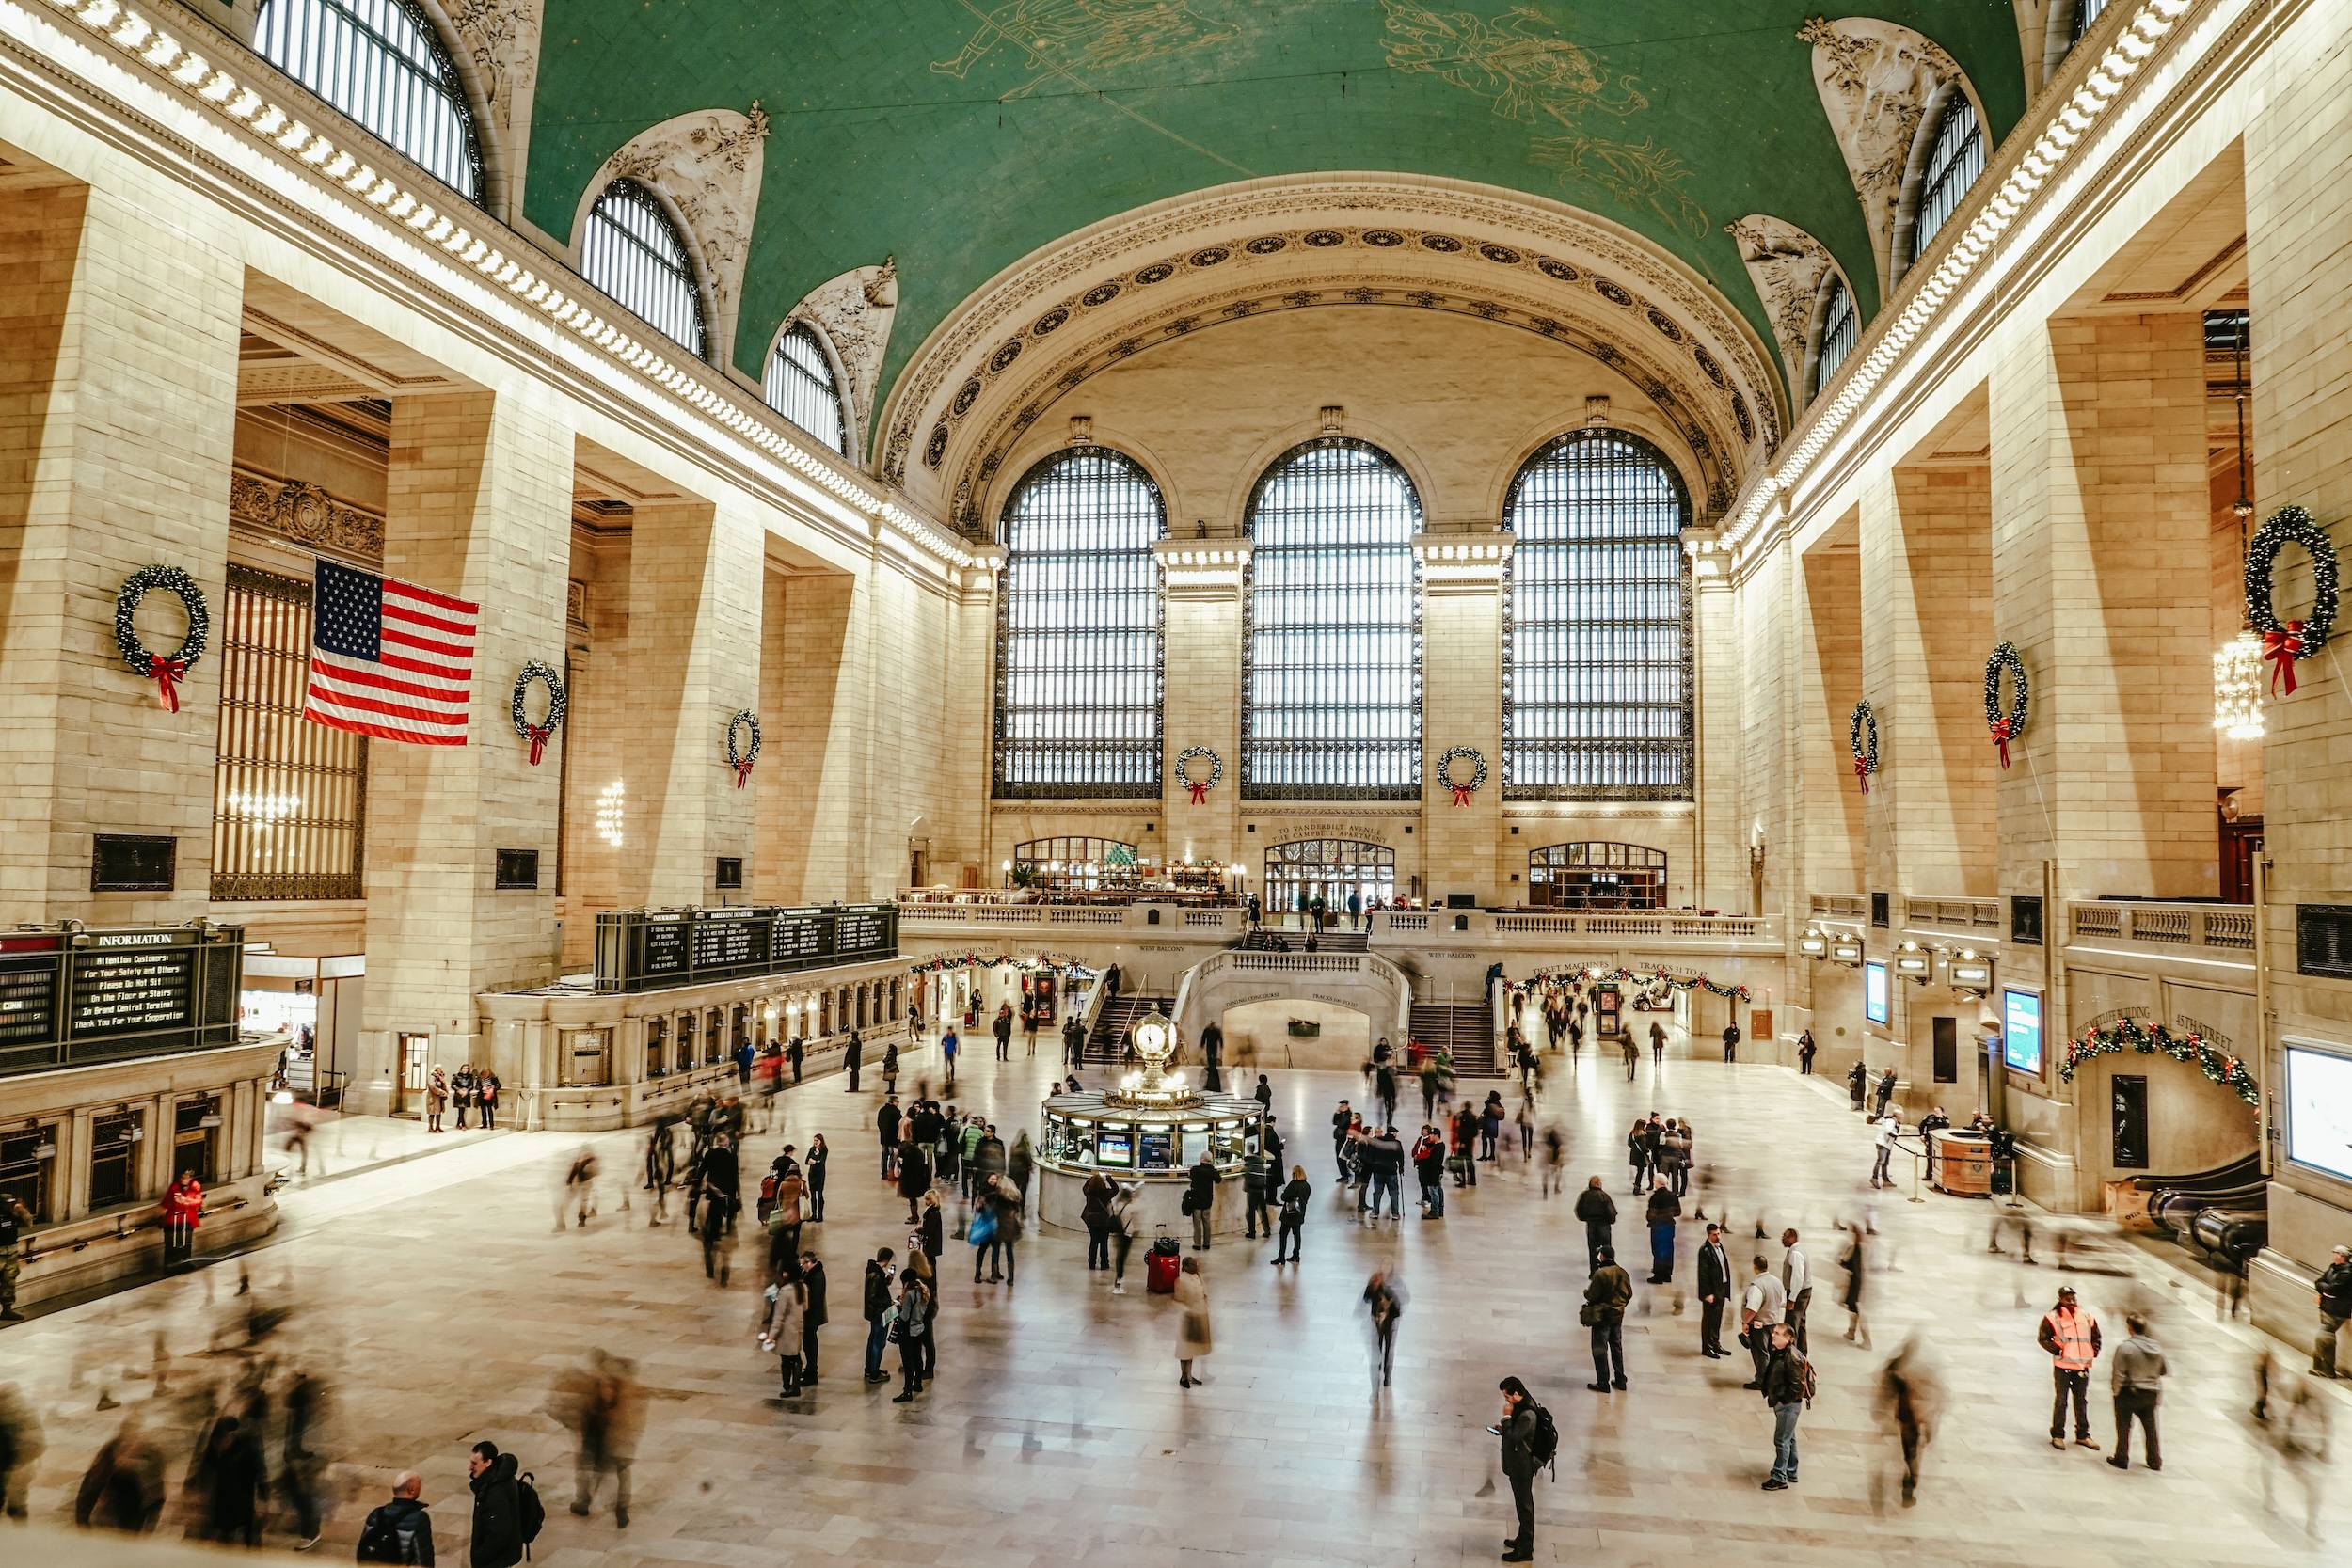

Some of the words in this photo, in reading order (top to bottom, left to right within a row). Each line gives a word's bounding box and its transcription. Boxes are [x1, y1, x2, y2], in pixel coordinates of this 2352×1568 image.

[1349, 825, 1382, 835] AVENUE
[1293, 830, 1334, 839] CAMPBELL
[1339, 831, 1387, 843] APARTMENT
[99, 934, 172, 946] INFORMATION
[922, 950, 950, 960] TICKET
[953, 947, 994, 955] MACHINES
[1057, 952, 1077, 961] 42ND
[97, 956, 131, 965] Attention
[1639, 962, 1673, 971] TRACKS
[118, 968, 142, 976] Safety
[1533, 965, 1561, 975] TICKET
[1565, 961, 1609, 970] MACHINES
[99, 981, 123, 989] Please
[117, 992, 137, 1000] Floor
[149, 990, 171, 998] Stairs
[1226, 998, 1247, 1007] DINING
[1248, 992, 1280, 1001] CONCOURSE
[94, 1006, 114, 1015] Grand
[116, 1003, 142, 1012] Central
[146, 1000, 173, 1010] Terminal
[75, 1020, 94, 1029] Thank
[145, 1012, 184, 1022] Cooperation
[2077, 1022, 2088, 1038] THE
[2089, 1010, 2116, 1027] METLIFE
[2117, 1006, 2150, 1019] BUILDING
[2176, 1014, 2197, 1033] 45TH
[2199, 1022, 2233, 1051] STREET
